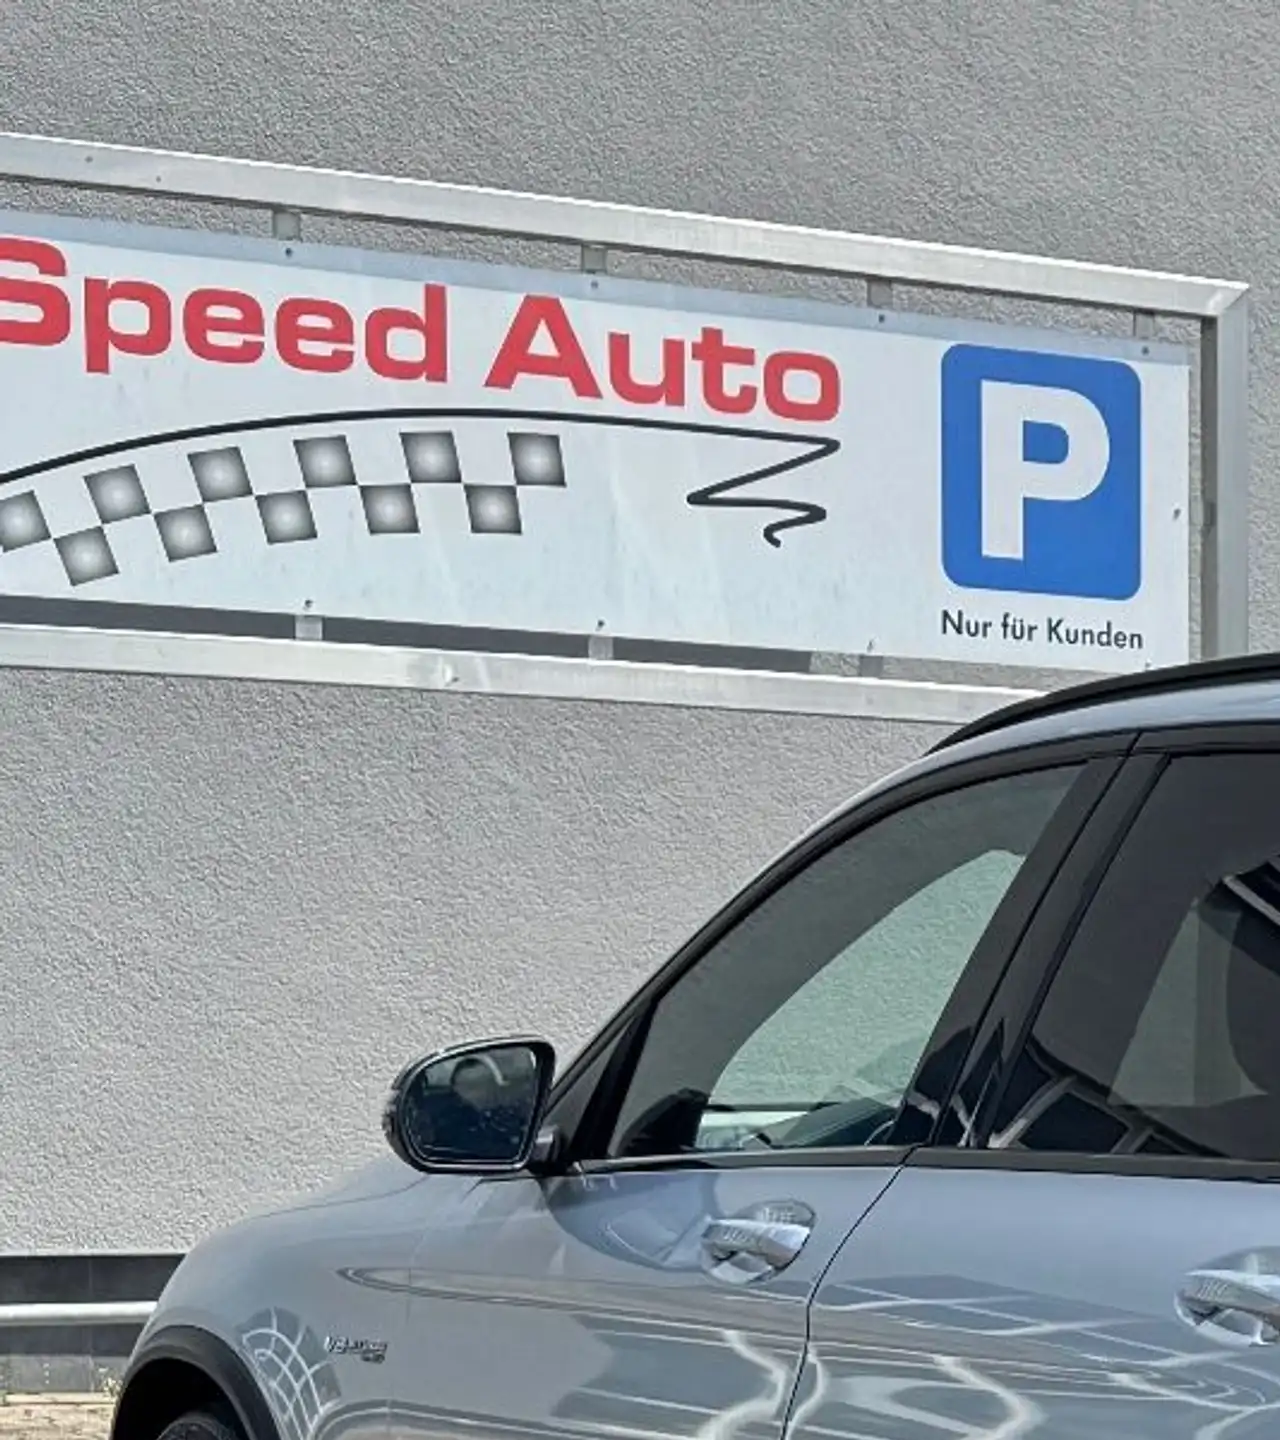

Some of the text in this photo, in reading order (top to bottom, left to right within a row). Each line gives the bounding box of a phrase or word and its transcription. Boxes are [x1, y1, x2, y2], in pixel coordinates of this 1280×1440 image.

[0, 236, 842, 422] Speed Auto
[979, 379, 1111, 562] P
[940, 608, 1145, 651] Nur für Kunden
